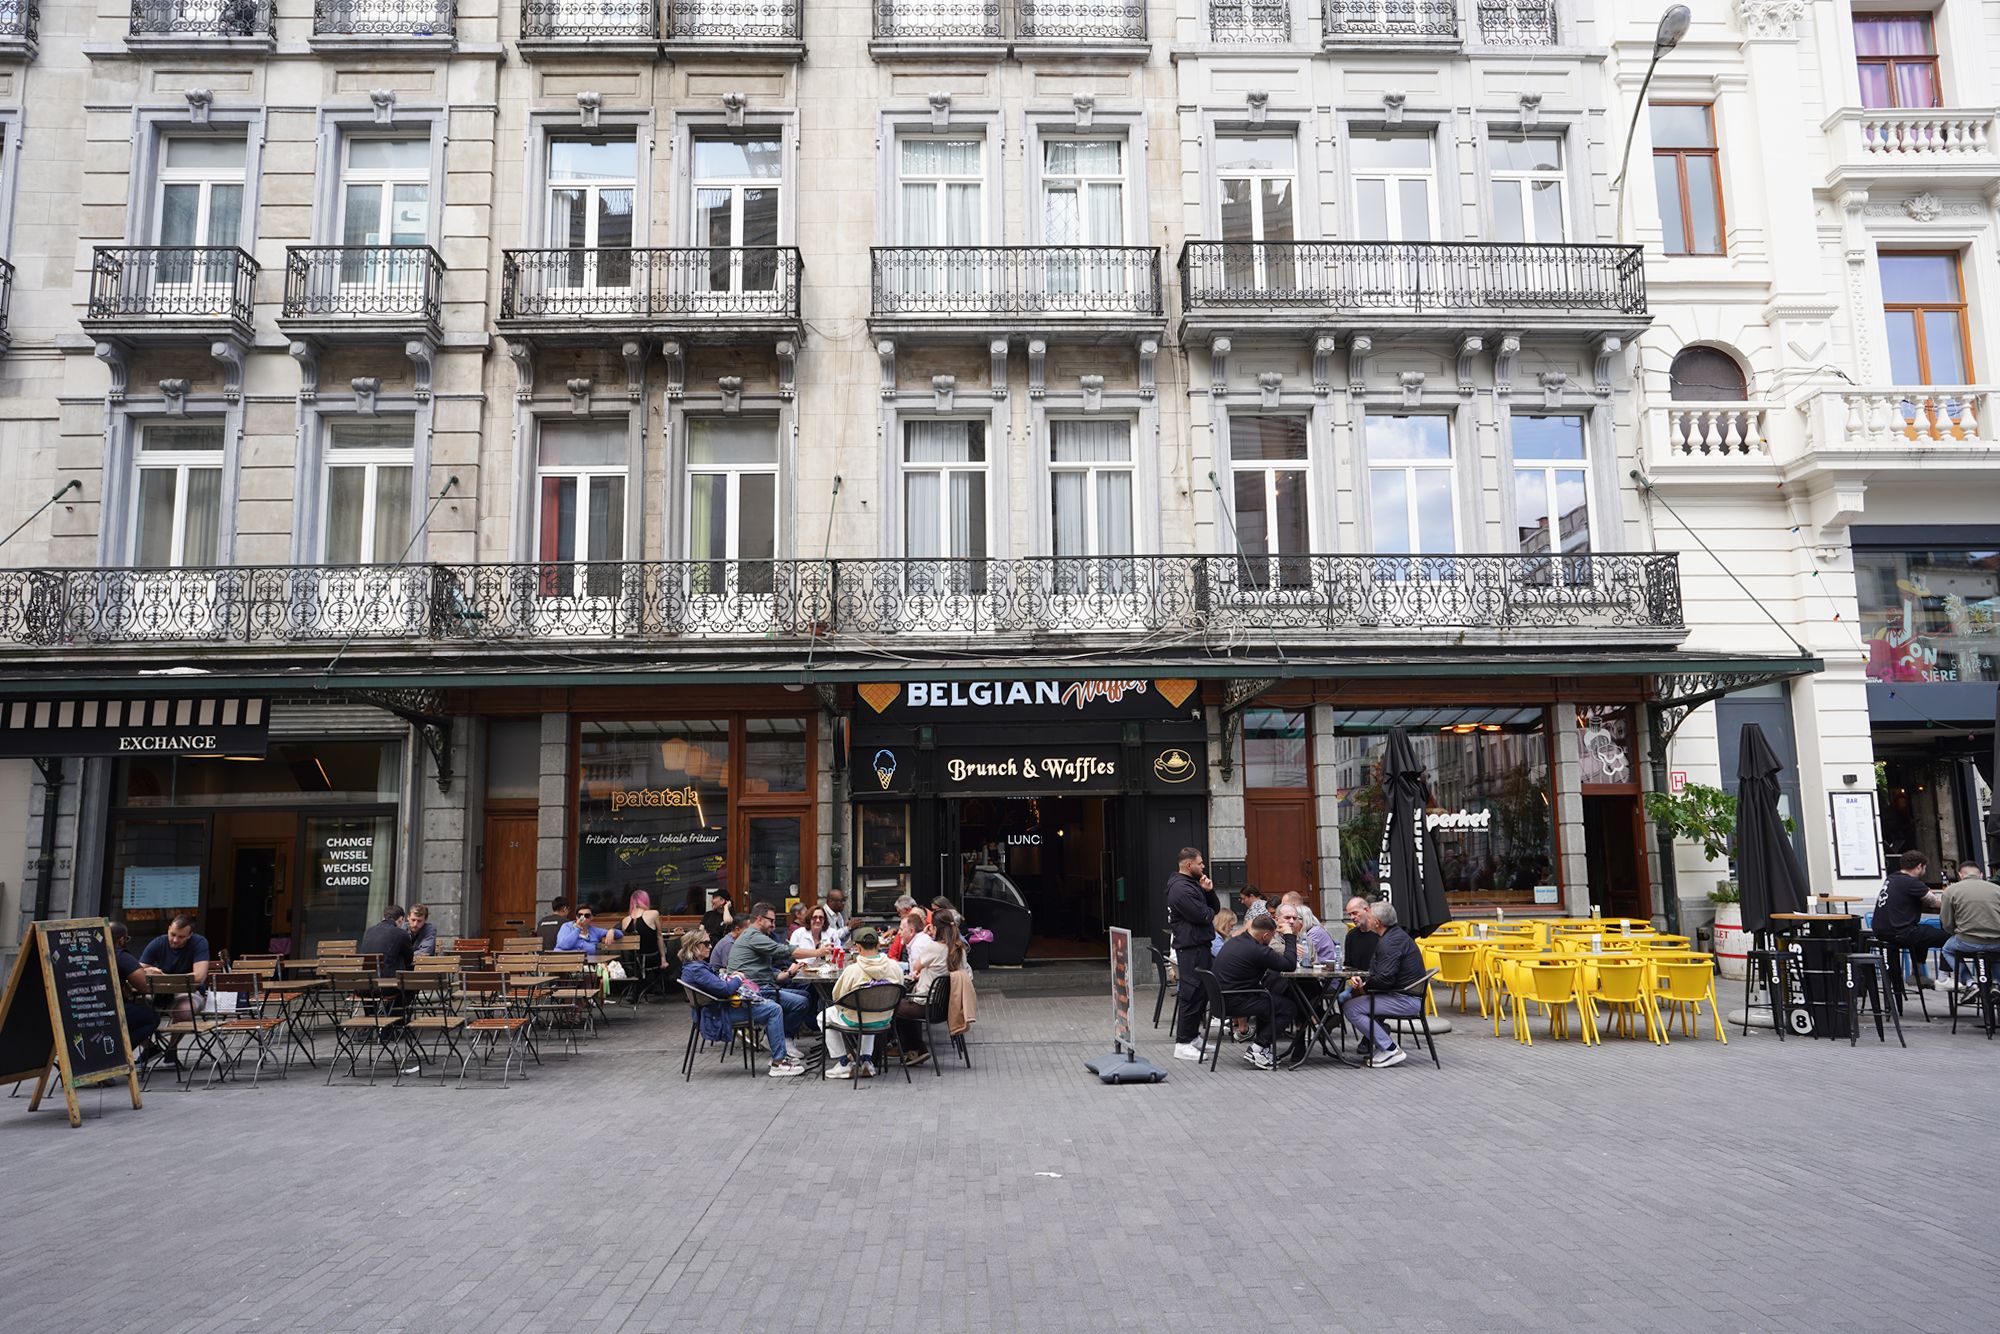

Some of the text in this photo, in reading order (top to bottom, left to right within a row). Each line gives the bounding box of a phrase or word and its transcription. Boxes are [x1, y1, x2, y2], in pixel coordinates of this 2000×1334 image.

[907, 679, 1148, 710] BELGIAN Waffles
[119, 736, 216, 750] EXCHANGE
[948, 757, 1115, 782] Brunch & Waffles
[611, 786, 700, 813] patatak
[326, 837, 373, 847] CHANGE
[586, 834, 618, 844] friterie
[619, 834, 649, 844] locale
[659, 833, 688, 843] lokale
[688, 832, 720, 843] frituur
[1007, 834, 1043, 845] LUNC
[330, 850, 368, 860] WISSEL
[323, 863, 374, 873] WECHSEL
[325, 876, 370, 886] CAMBIO
[1788, 943, 1807, 1005] SUPER
[1795, 1014, 1808, 1029] 8
